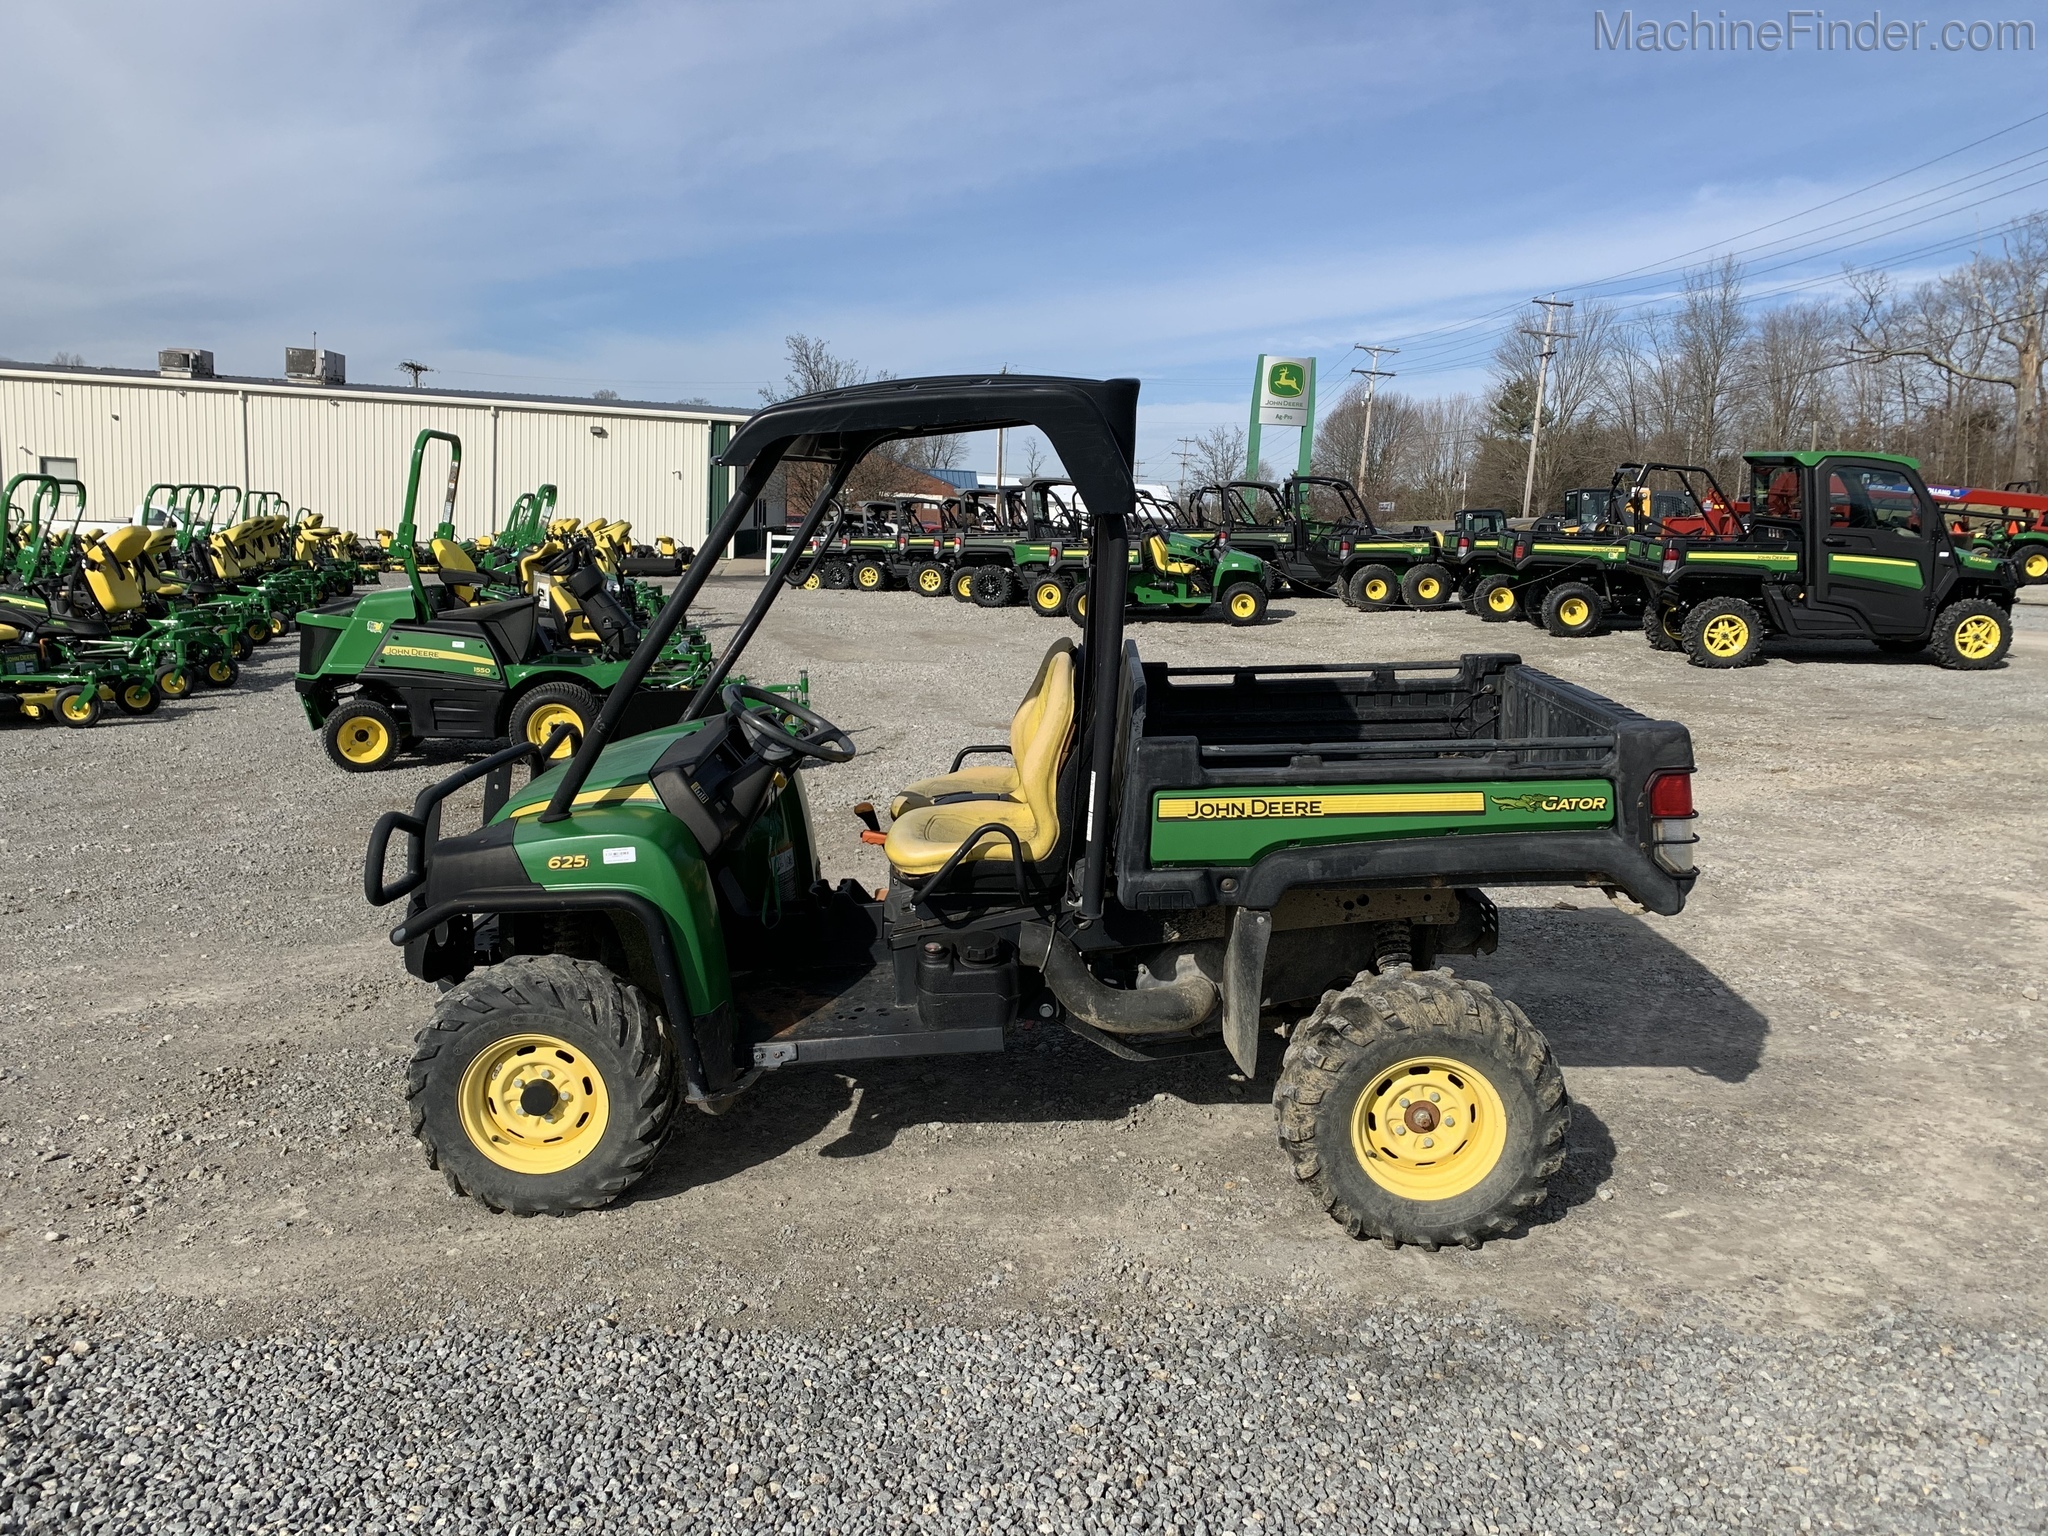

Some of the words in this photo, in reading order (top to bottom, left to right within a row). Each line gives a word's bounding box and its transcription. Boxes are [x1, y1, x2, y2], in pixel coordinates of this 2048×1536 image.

[1275, 413, 1293, 421] Ag-Pro
[387, 647, 410, 655] JOHN
[411, 648, 440, 658] DEERE
[473, 666, 491, 674] 1550
[1187, 800, 1246, 818] JOHN
[1250, 799, 1323, 816] DEERE
[1541, 796, 1607, 812] GATOR
[547, 854, 590, 871] 625i
